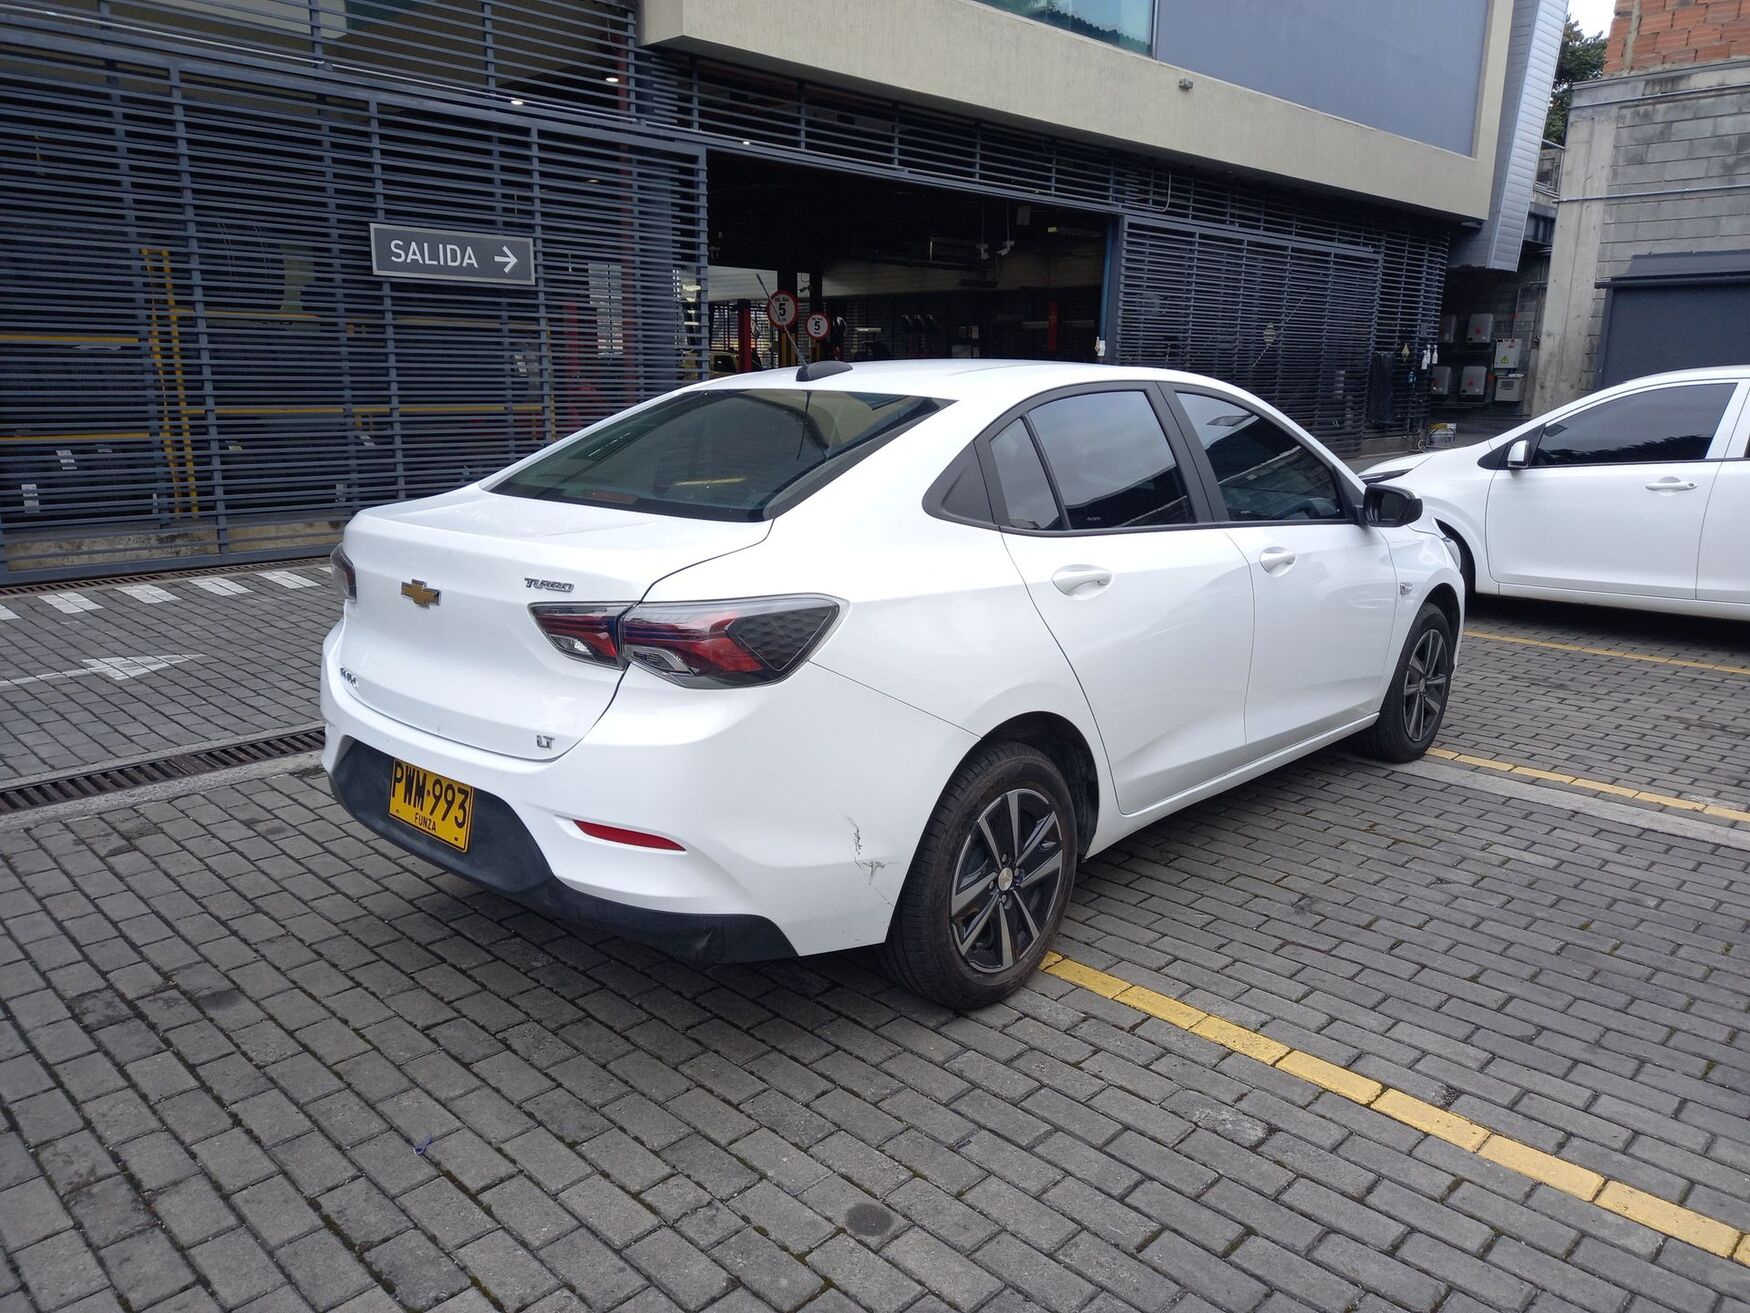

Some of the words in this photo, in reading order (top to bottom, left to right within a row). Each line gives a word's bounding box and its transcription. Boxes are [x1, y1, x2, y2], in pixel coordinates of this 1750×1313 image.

[390, 239, 478, 268] SALIDA
[778, 302, 786, 316] 5
[814, 321, 821, 331] 5
[524, 577, 575, 593] TURBO
[536, 734, 556, 750] LT
[414, 812, 437, 833] FUNZA
